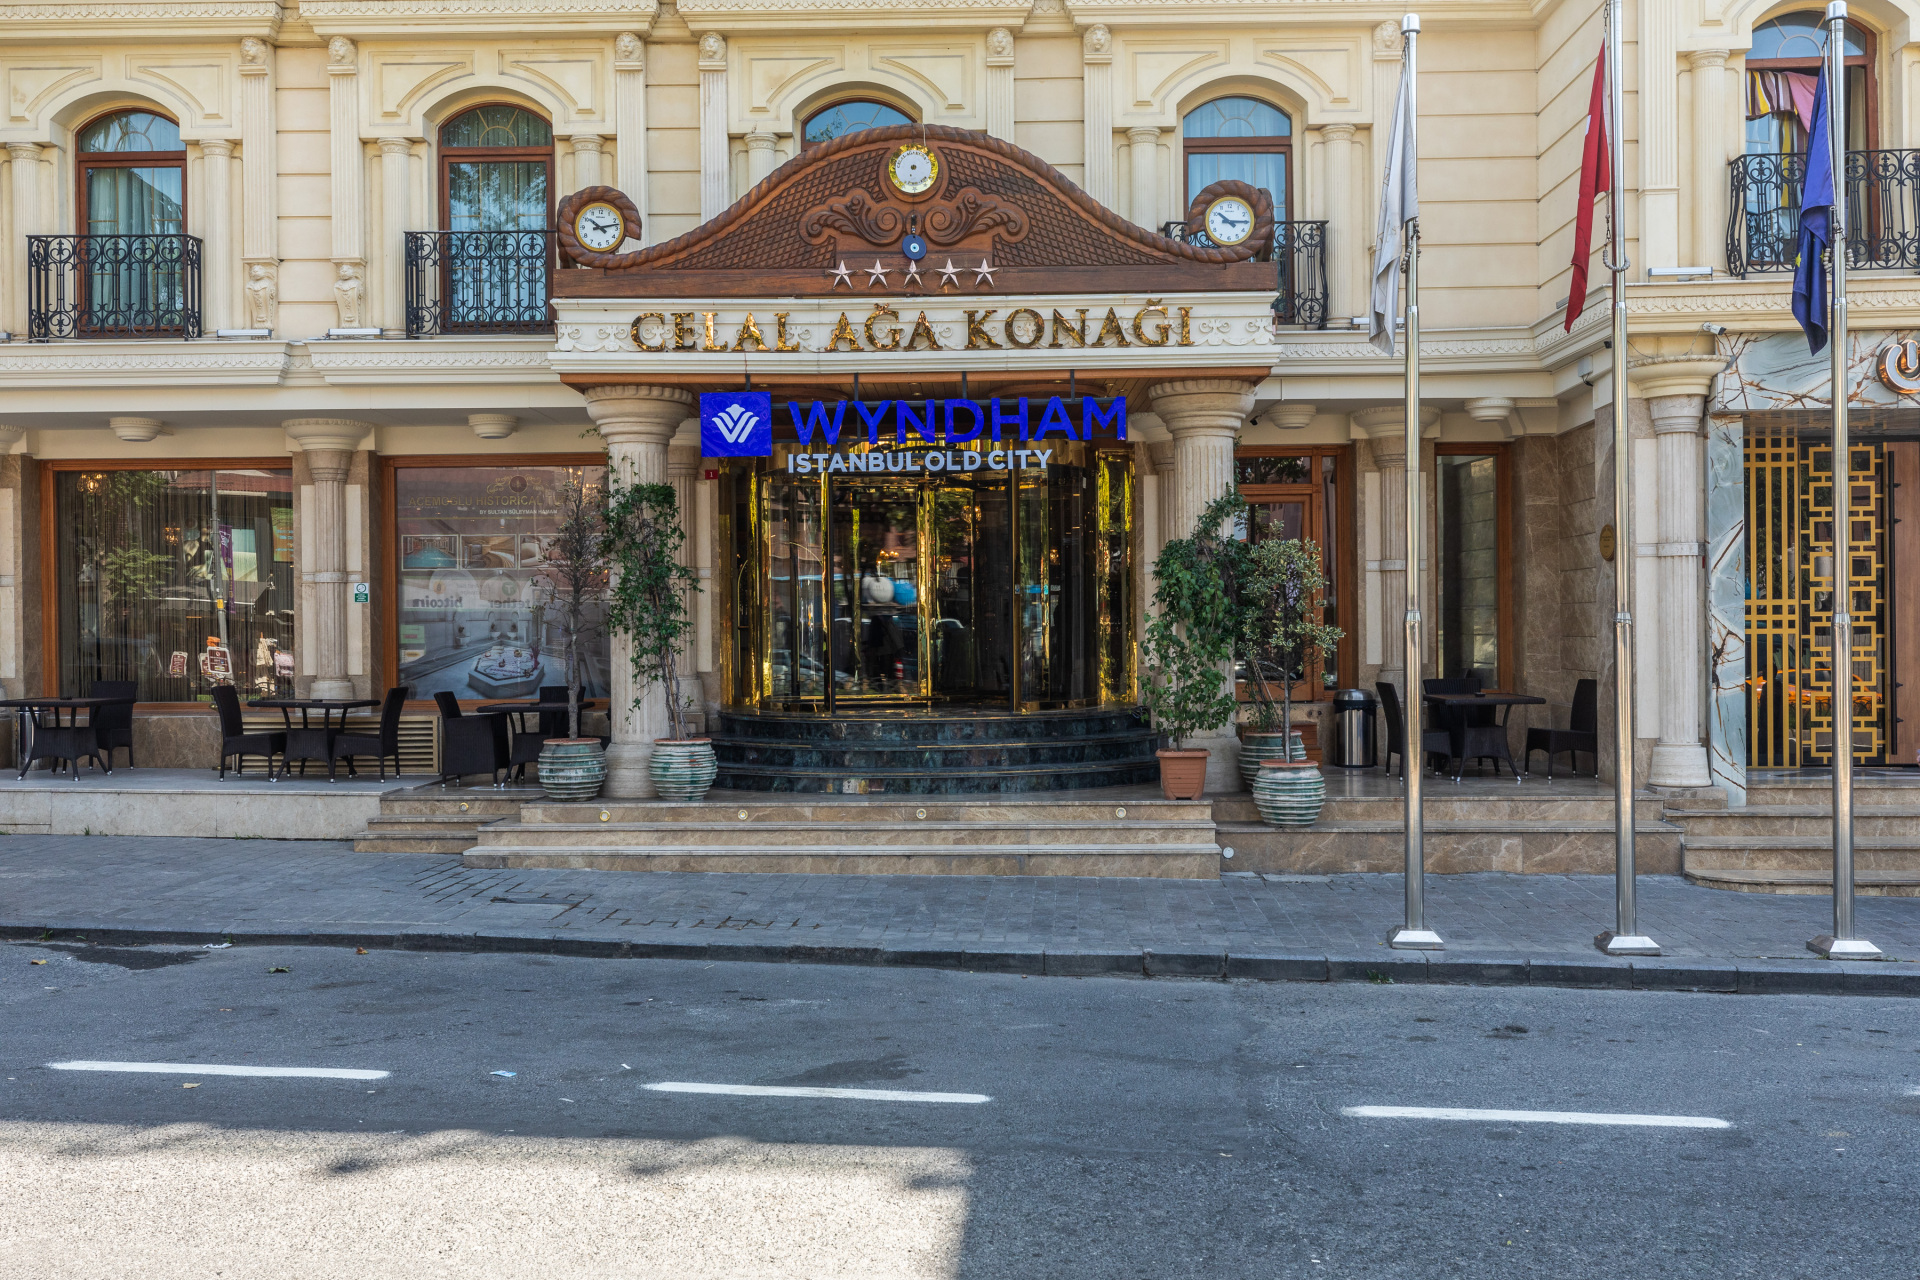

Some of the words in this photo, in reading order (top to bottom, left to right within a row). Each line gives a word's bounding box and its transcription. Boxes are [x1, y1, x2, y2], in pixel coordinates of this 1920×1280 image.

[630, 312, 800, 351] CELAL
[824, 303, 944, 350] AĞA
[963, 297, 1194, 348] KONAĞI
[787, 396, 1126, 446] WYNDHAM
[788, 451, 921, 473] ISTANBUL
[924, 450, 982, 472] OLD
[987, 449, 1053, 470] CITY
[476, 495, 543, 506] HISTORICAL
